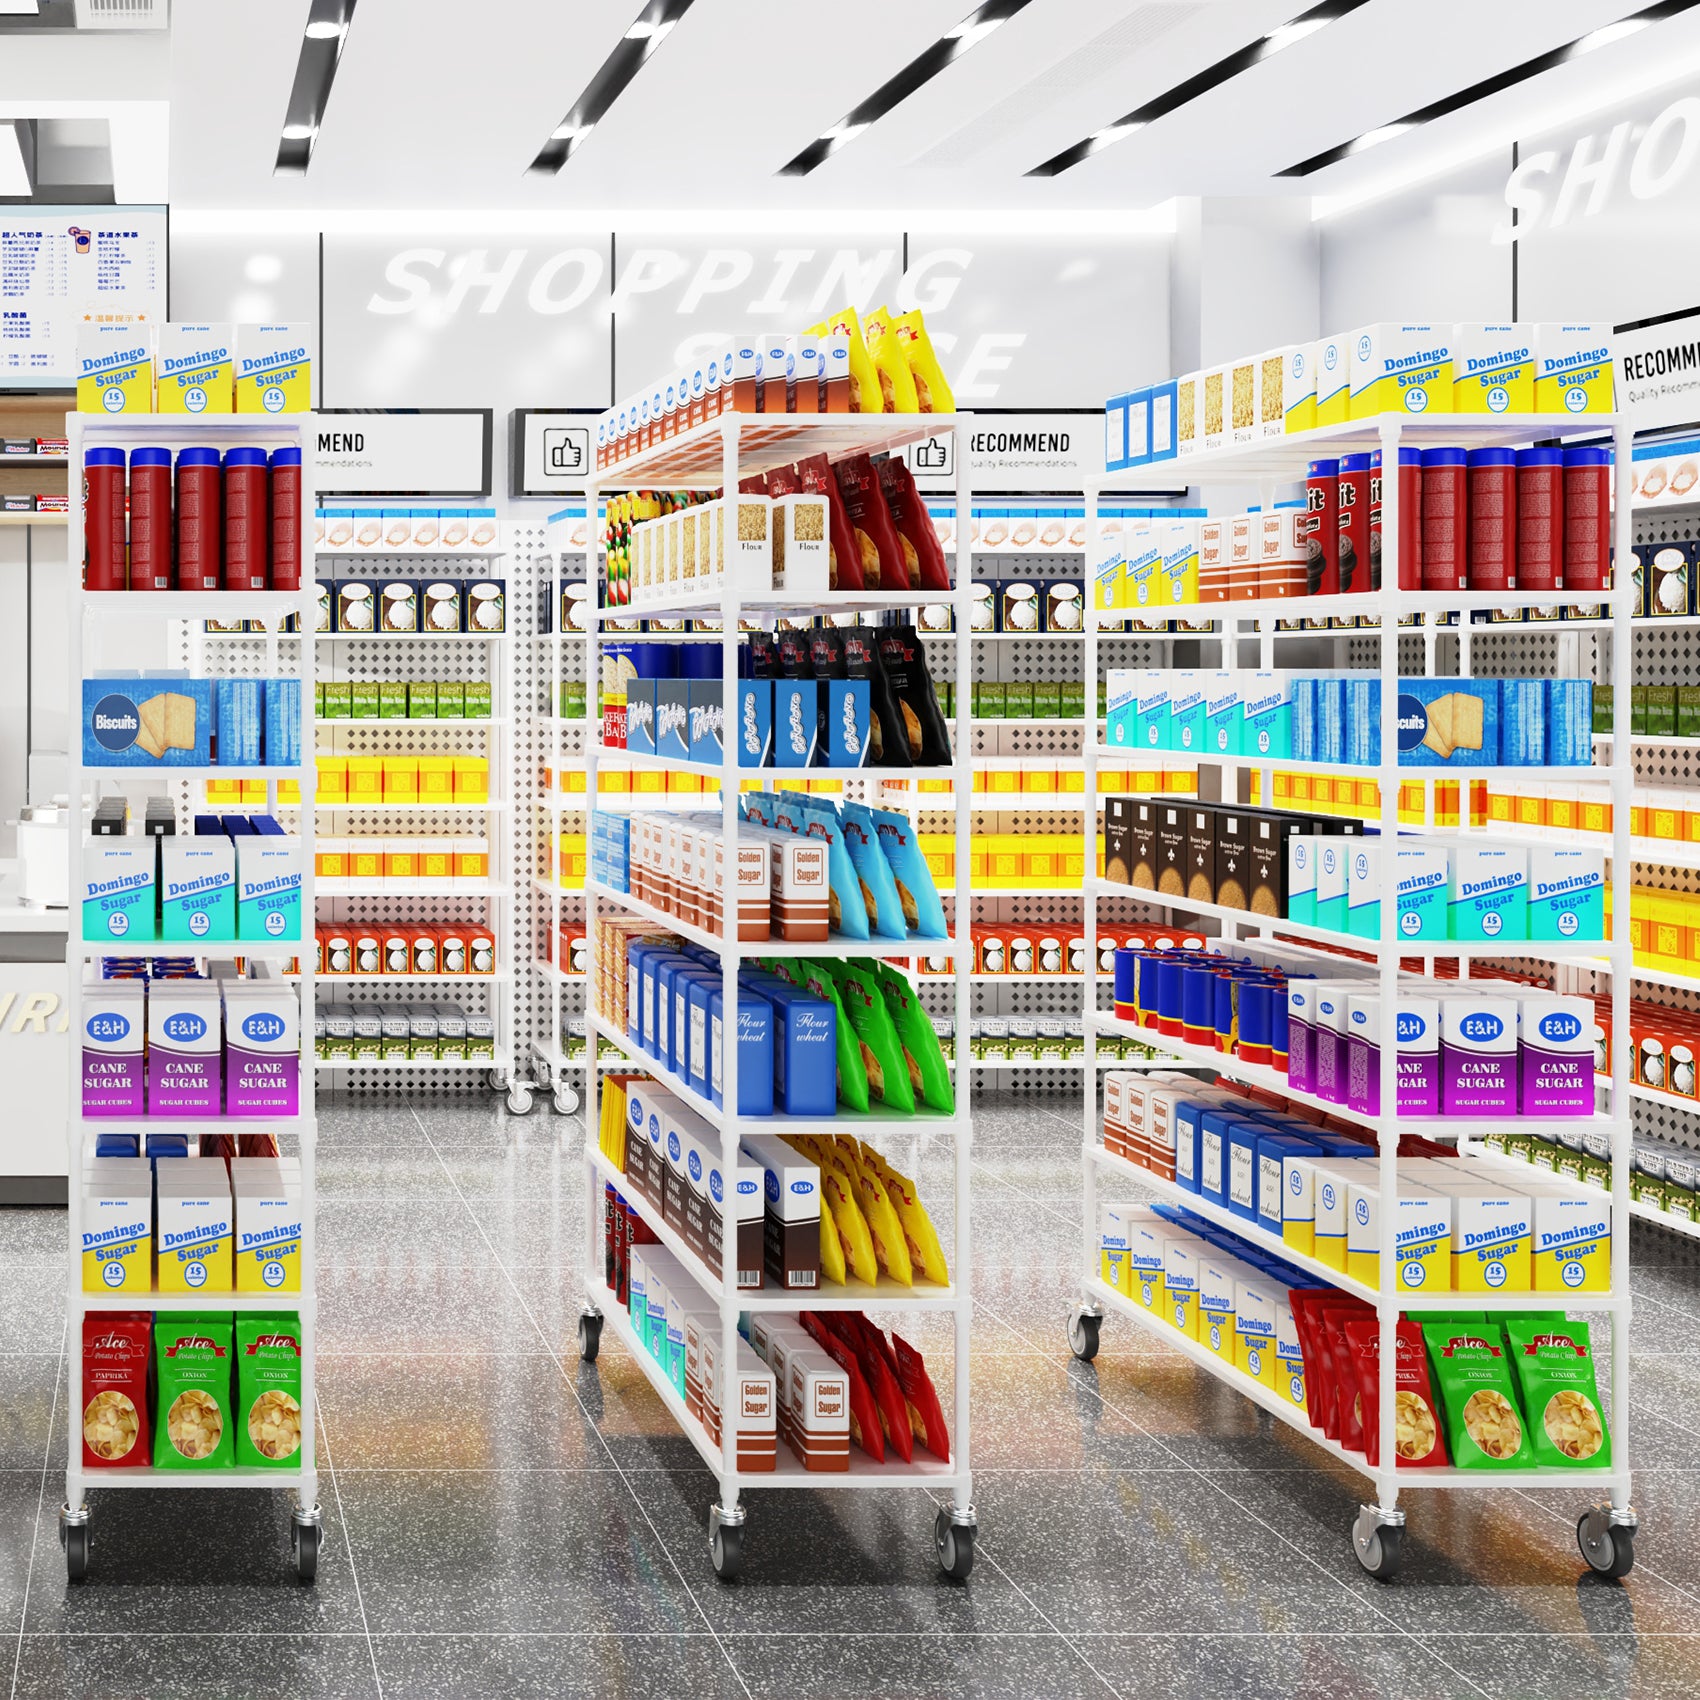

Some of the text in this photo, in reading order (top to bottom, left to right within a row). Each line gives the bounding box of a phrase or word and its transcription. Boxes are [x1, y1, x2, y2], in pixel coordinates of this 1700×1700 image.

[366, 247, 974, 316] SHOPPING
[82, 347, 145, 371] Domingo
[164, 347, 227, 371] Domingo
[242, 347, 306, 371] Domingo
[1384, 347, 1448, 372] Domingo
[1467, 347, 1529, 372] Domingo
[1544, 347, 1609, 372] Domingo
[95, 369, 138, 387] Sugar
[177, 369, 219, 387] Sugar
[255, 369, 297, 387] Sugar
[1397, 369, 1440, 387] Sugar
[1480, 369, 1521, 387] Sugar
[1557, 369, 1600, 387] Sugar
[1247, 691, 1282, 714] Domingo
[95, 714, 138, 731] Biscuits
[1253, 712, 1277, 729] Sugar
[797, 851, 820, 863] Golden
[87, 871, 150, 896] Domingo
[168, 871, 230, 896] Domingo
[797, 870, 820, 882] Sugar
[1462, 871, 1523, 896] Domingo
[1537, 871, 1600, 896] Domingo
[100, 892, 142, 911] Sugar
[181, 892, 222, 911] Sugar
[257, 892, 298, 911] Sugar
[1474, 892, 1515, 911] Sugar
[1550, 892, 1592, 911] Sugar
[93, 1020, 125, 1035] E&H
[169, 1020, 201, 1035] E&H
[247, 1020, 280, 1035] E&H
[795, 1012, 829, 1029] Flour
[1466, 1021, 1498, 1036] E&H
[1544, 1021, 1577, 1036] E&H
[796, 1030, 829, 1042] wheat
[88, 1063, 127, 1074] CANE
[165, 1063, 204, 1074] CANE
[243, 1063, 282, 1074] CANE
[1461, 1063, 1500, 1074] CANE
[1540, 1063, 1579, 1074] CANE
[83, 1078, 132, 1089] SUGAR
[160, 1078, 209, 1089] SUGAR
[239, 1078, 288, 1089] SUGAR
[1456, 1077, 1506, 1088] SUGAR
[1535, 1077, 1583, 1088] SUGAR
[791, 1183, 813, 1192] E&H
[82, 1221, 146, 1247] Domingo
[164, 1221, 227, 1247] Domingo
[1464, 1220, 1527, 1247] Domingo
[1541, 1220, 1606, 1247] Domingo
[95, 1243, 138, 1262] Sugar
[177, 1243, 219, 1262] Sugar
[255, 1243, 297, 1262] Sugar
[1477, 1242, 1519, 1261] Sugar
[1555, 1242, 1598, 1261] Sugar
[1237, 1315, 1273, 1332] Domingo
[1244, 1335, 1268, 1351] Sugar
[745, 1385, 768, 1396] Golden
[818, 1385, 841, 1396] Golden
[745, 1402, 768, 1414] Sugar
[818, 1402, 841, 1414] Sugar
